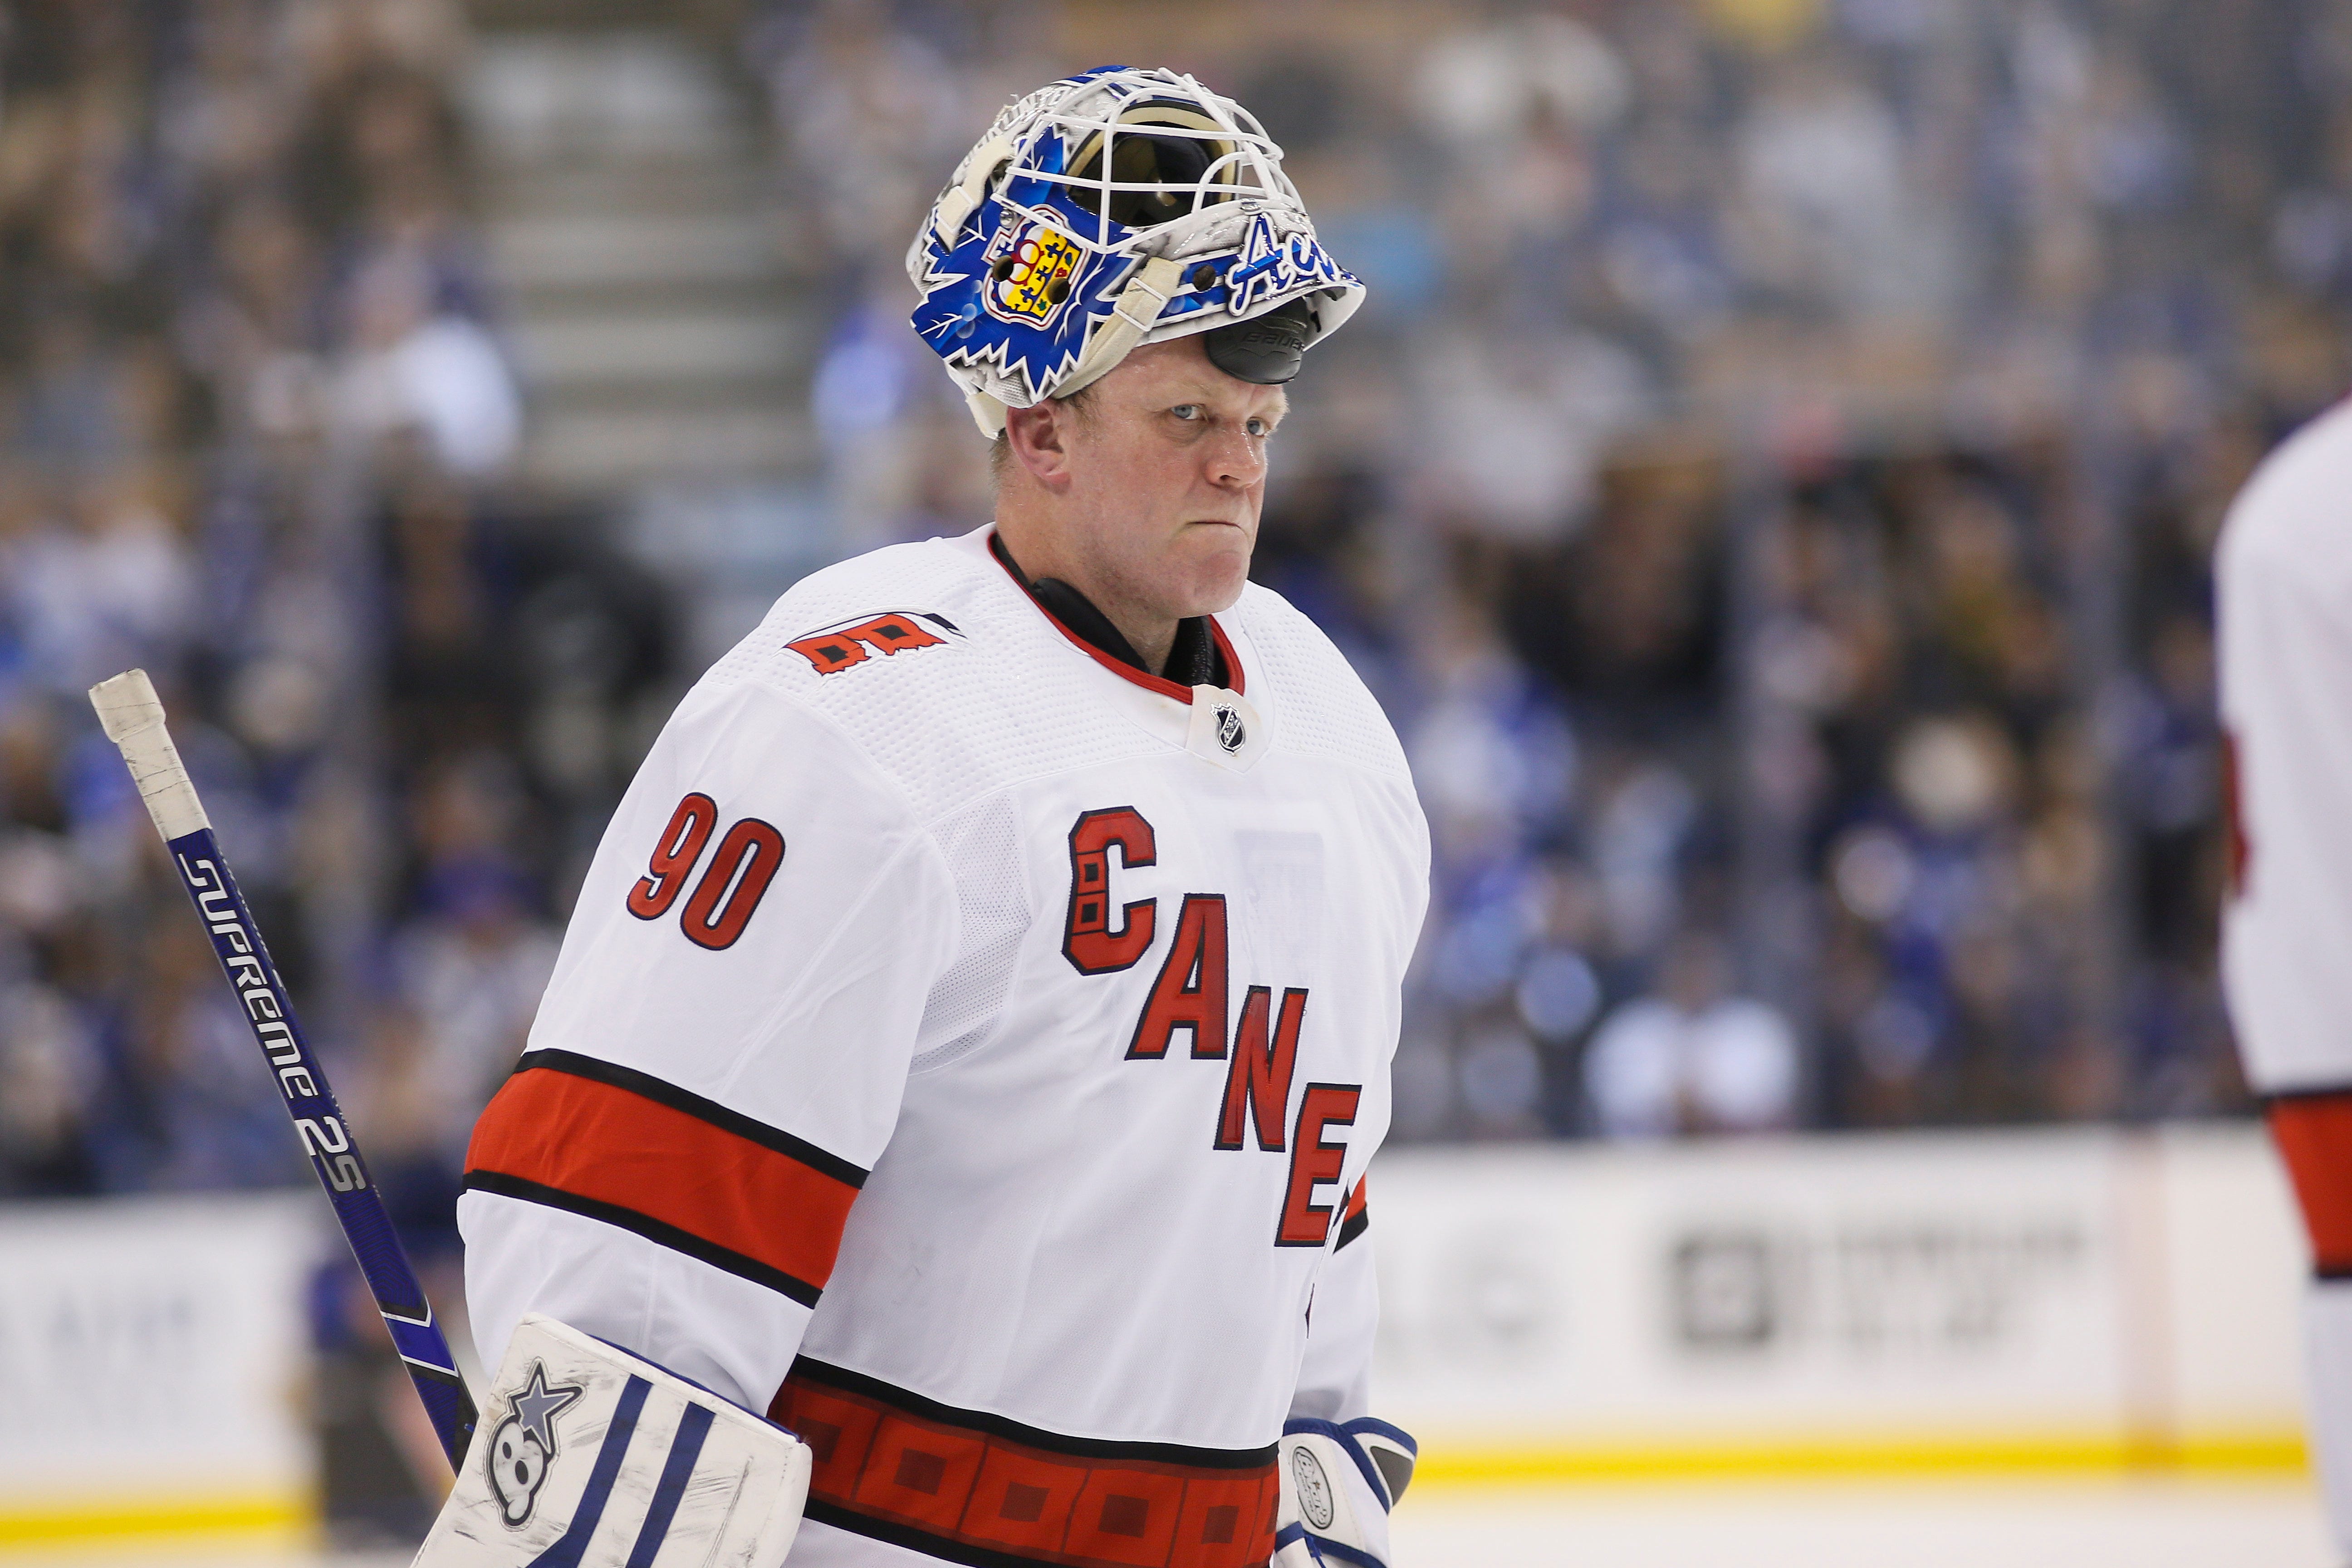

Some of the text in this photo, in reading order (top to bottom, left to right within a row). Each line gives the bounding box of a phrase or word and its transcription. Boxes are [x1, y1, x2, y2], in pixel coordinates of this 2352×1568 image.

[178, 853, 318, 1099] SUPREME
[294, 1115, 367, 1192] 2S
[627, 792, 785, 951] 90
[1061, 805, 1362, 1248] CANE
